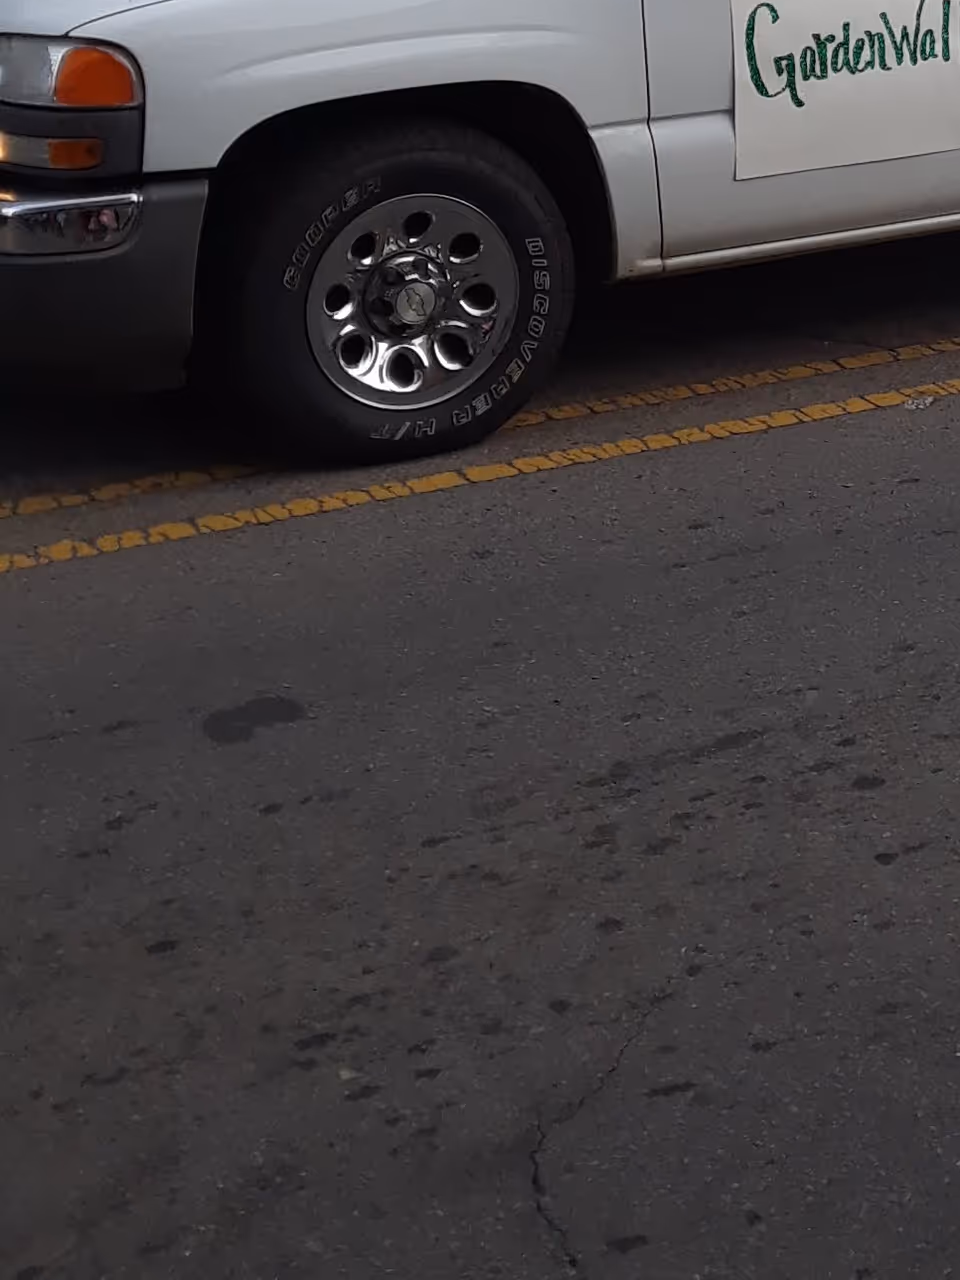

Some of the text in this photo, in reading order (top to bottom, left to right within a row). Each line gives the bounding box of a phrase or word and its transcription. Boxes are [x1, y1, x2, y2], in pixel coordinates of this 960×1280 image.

[283, 175, 382, 290] COOPER
[369, 237, 550, 441] DISCOVERER H/T
